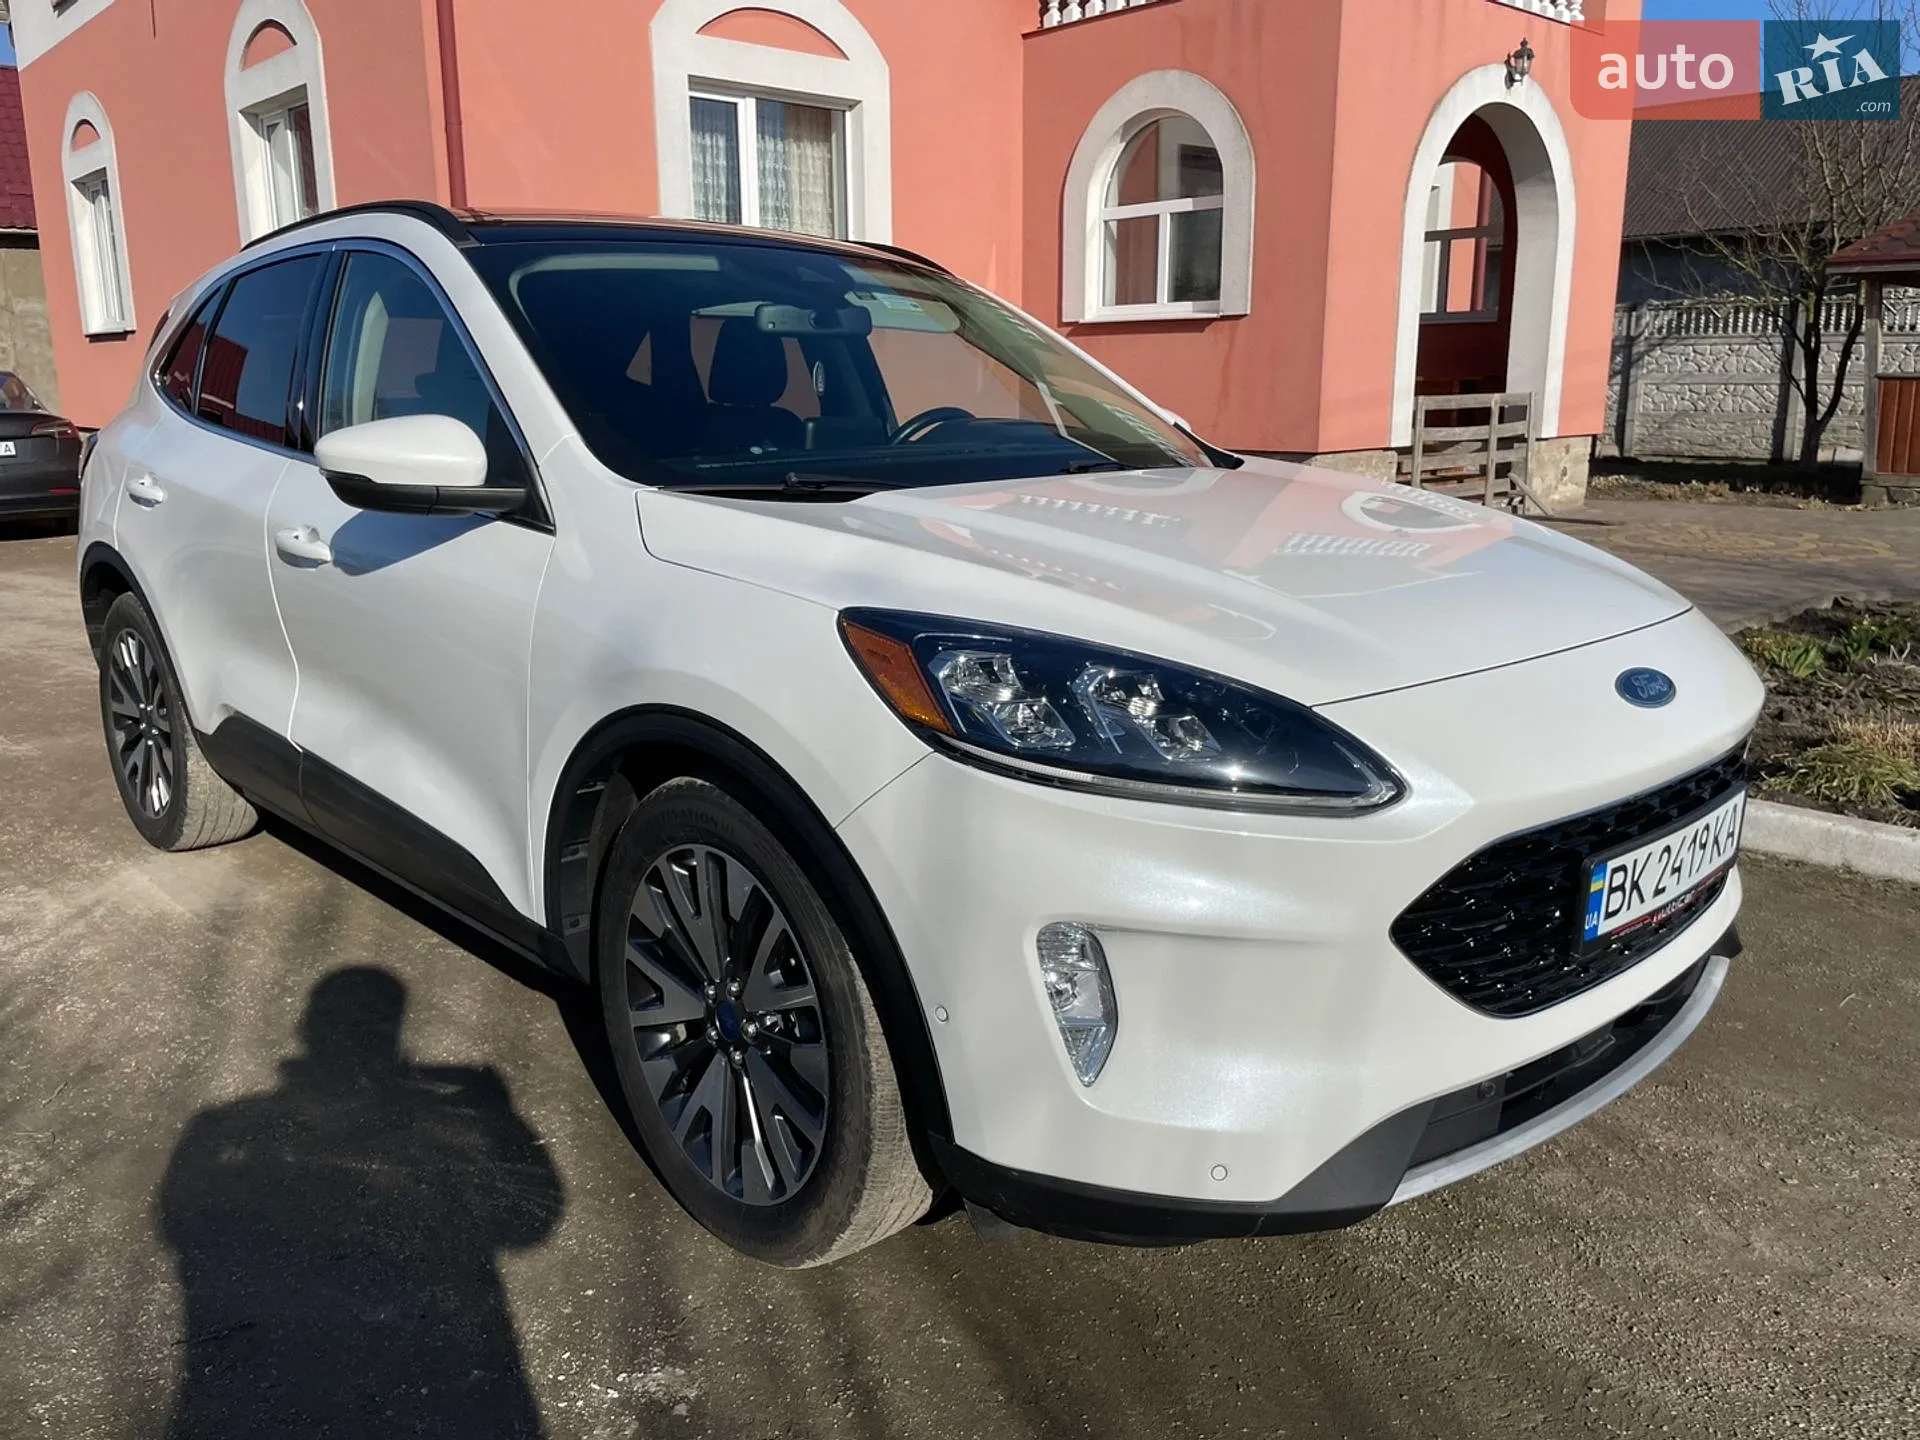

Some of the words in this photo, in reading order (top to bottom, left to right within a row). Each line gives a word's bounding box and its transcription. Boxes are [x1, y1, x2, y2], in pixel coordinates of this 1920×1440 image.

[1603, 851, 1652, 921] BK
[1652, 822, 1710, 898] 2419
[1709, 803, 1737, 864] KA
[1584, 910, 1598, 930] UA
